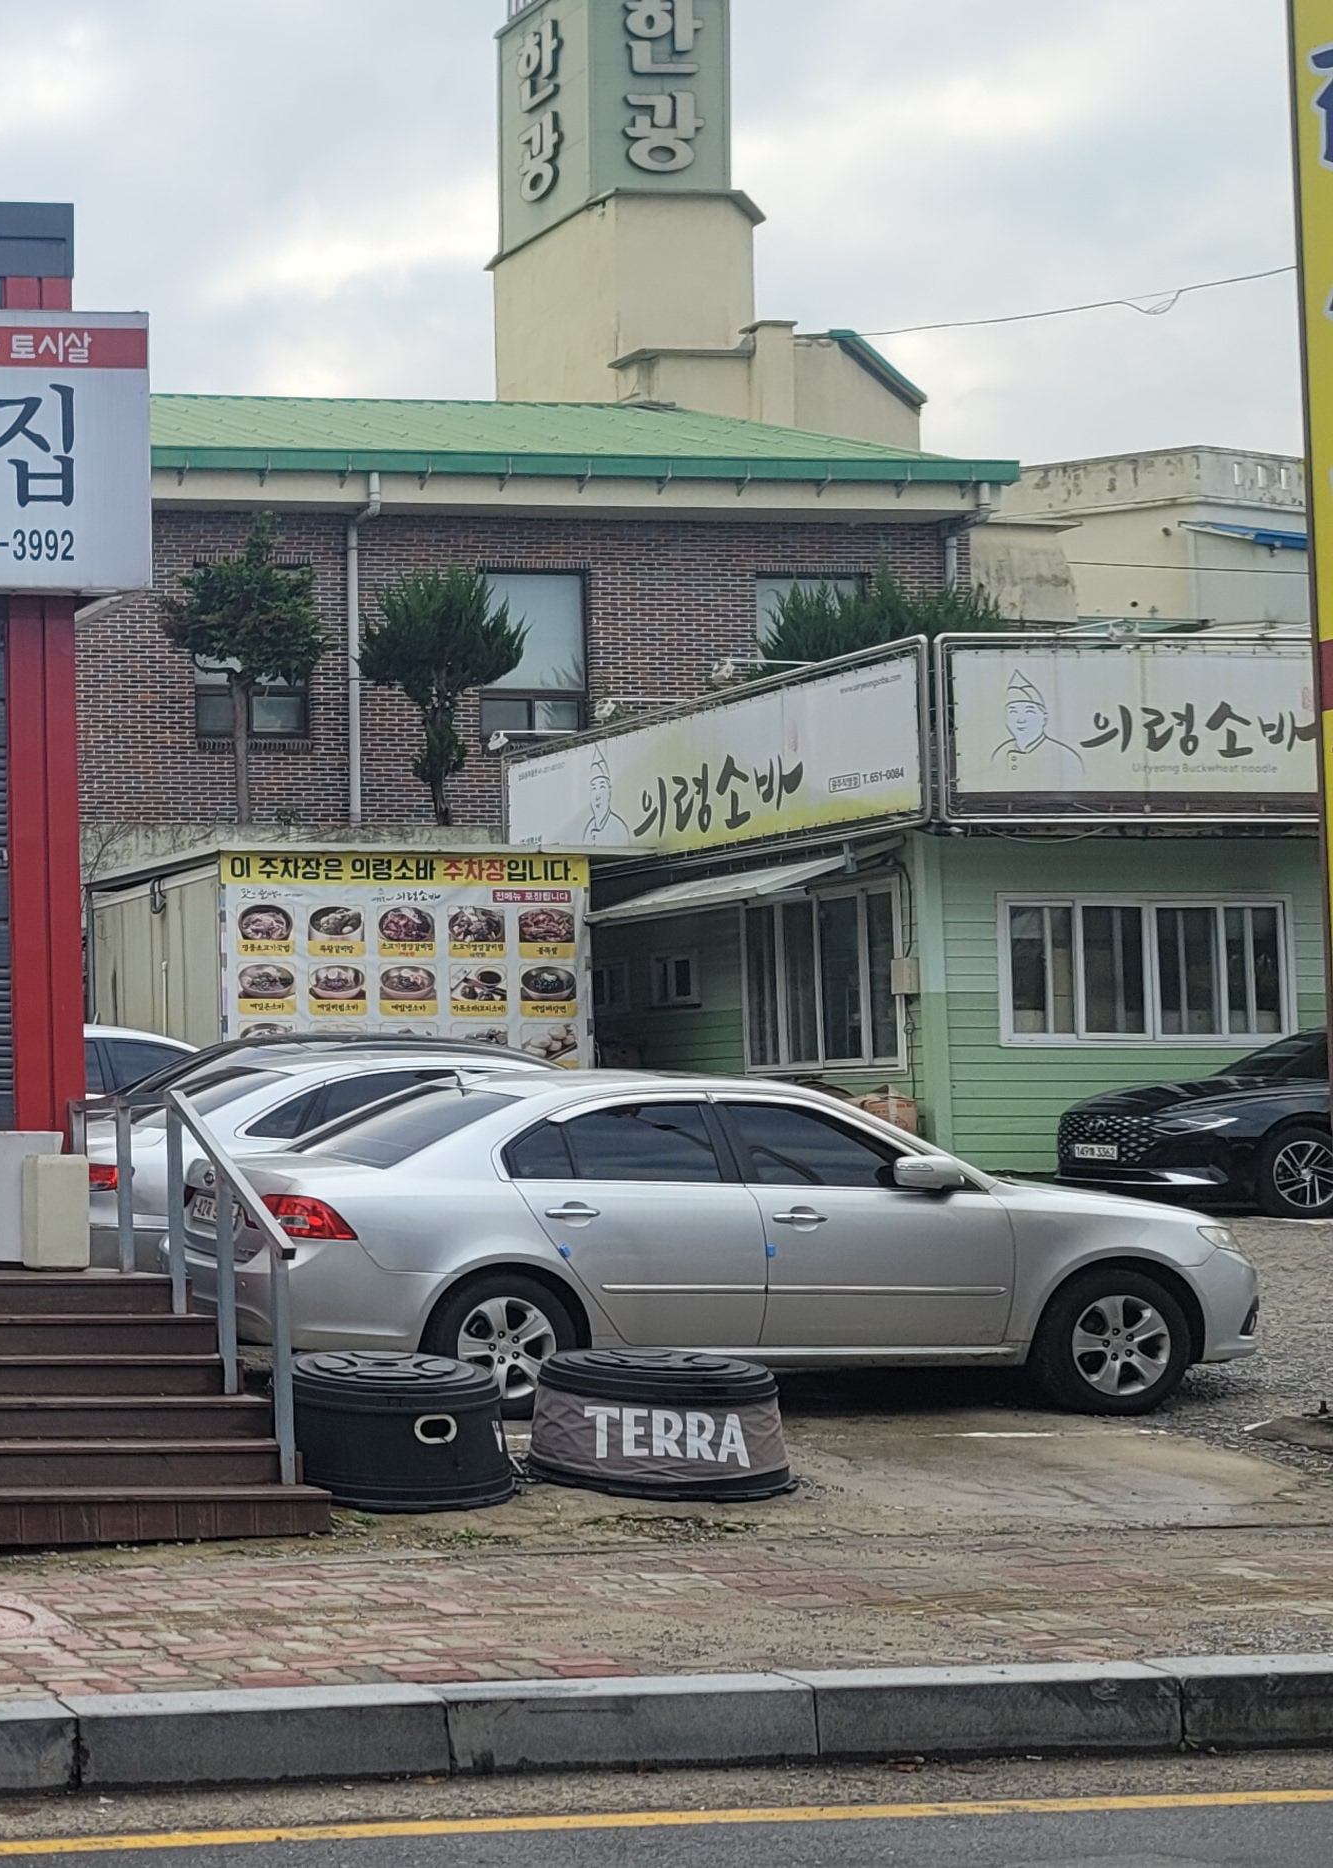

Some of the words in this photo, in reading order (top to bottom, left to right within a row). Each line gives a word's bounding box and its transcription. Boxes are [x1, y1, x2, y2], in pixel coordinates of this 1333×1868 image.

[517, 19, 560, 201] 한광
[624, 0, 704, 173] 한광
[11, 330, 92, 364] 토시살
[1079, 701, 1315, 758] 의령소바
[633, 754, 803, 838] 의령소바
[1183, 763, 1238, 774] Buckwheat
[231, 856, 251, 879] 이
[258, 856, 344, 883] 주차장은
[351, 857, 436, 882] 의령소바
[443, 858, 578, 883] 주차장입니다.
[584, 1405, 750, 1468] TERRA
